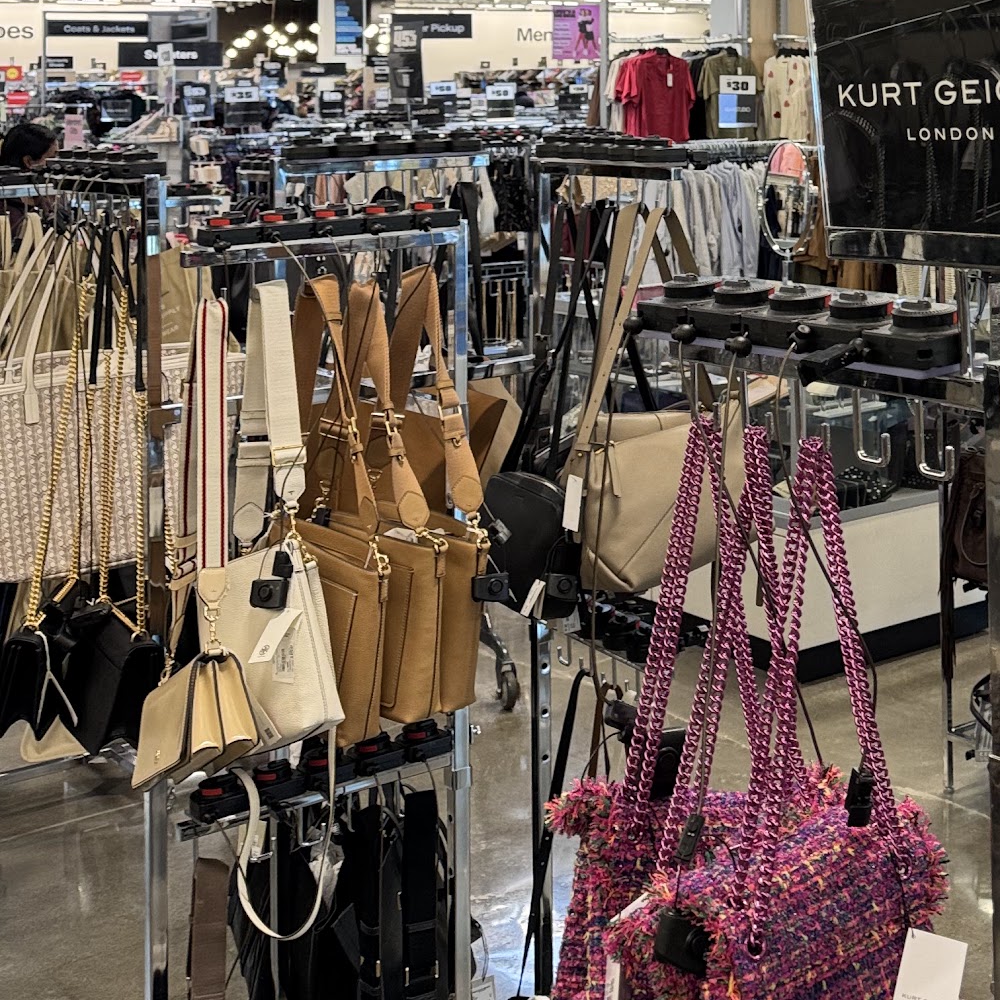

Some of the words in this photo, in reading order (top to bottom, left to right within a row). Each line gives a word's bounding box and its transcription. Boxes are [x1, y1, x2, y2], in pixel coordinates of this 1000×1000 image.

[63, 24, 91, 33] Coats
[92, 24, 100, 33] &
[102, 25, 136, 33] Jackets
[430, 23, 465, 34] Pickup
[726, 81, 749, 91] $30
[837, 81, 922, 107] KURT
[906, 126, 995, 142] LONDON
